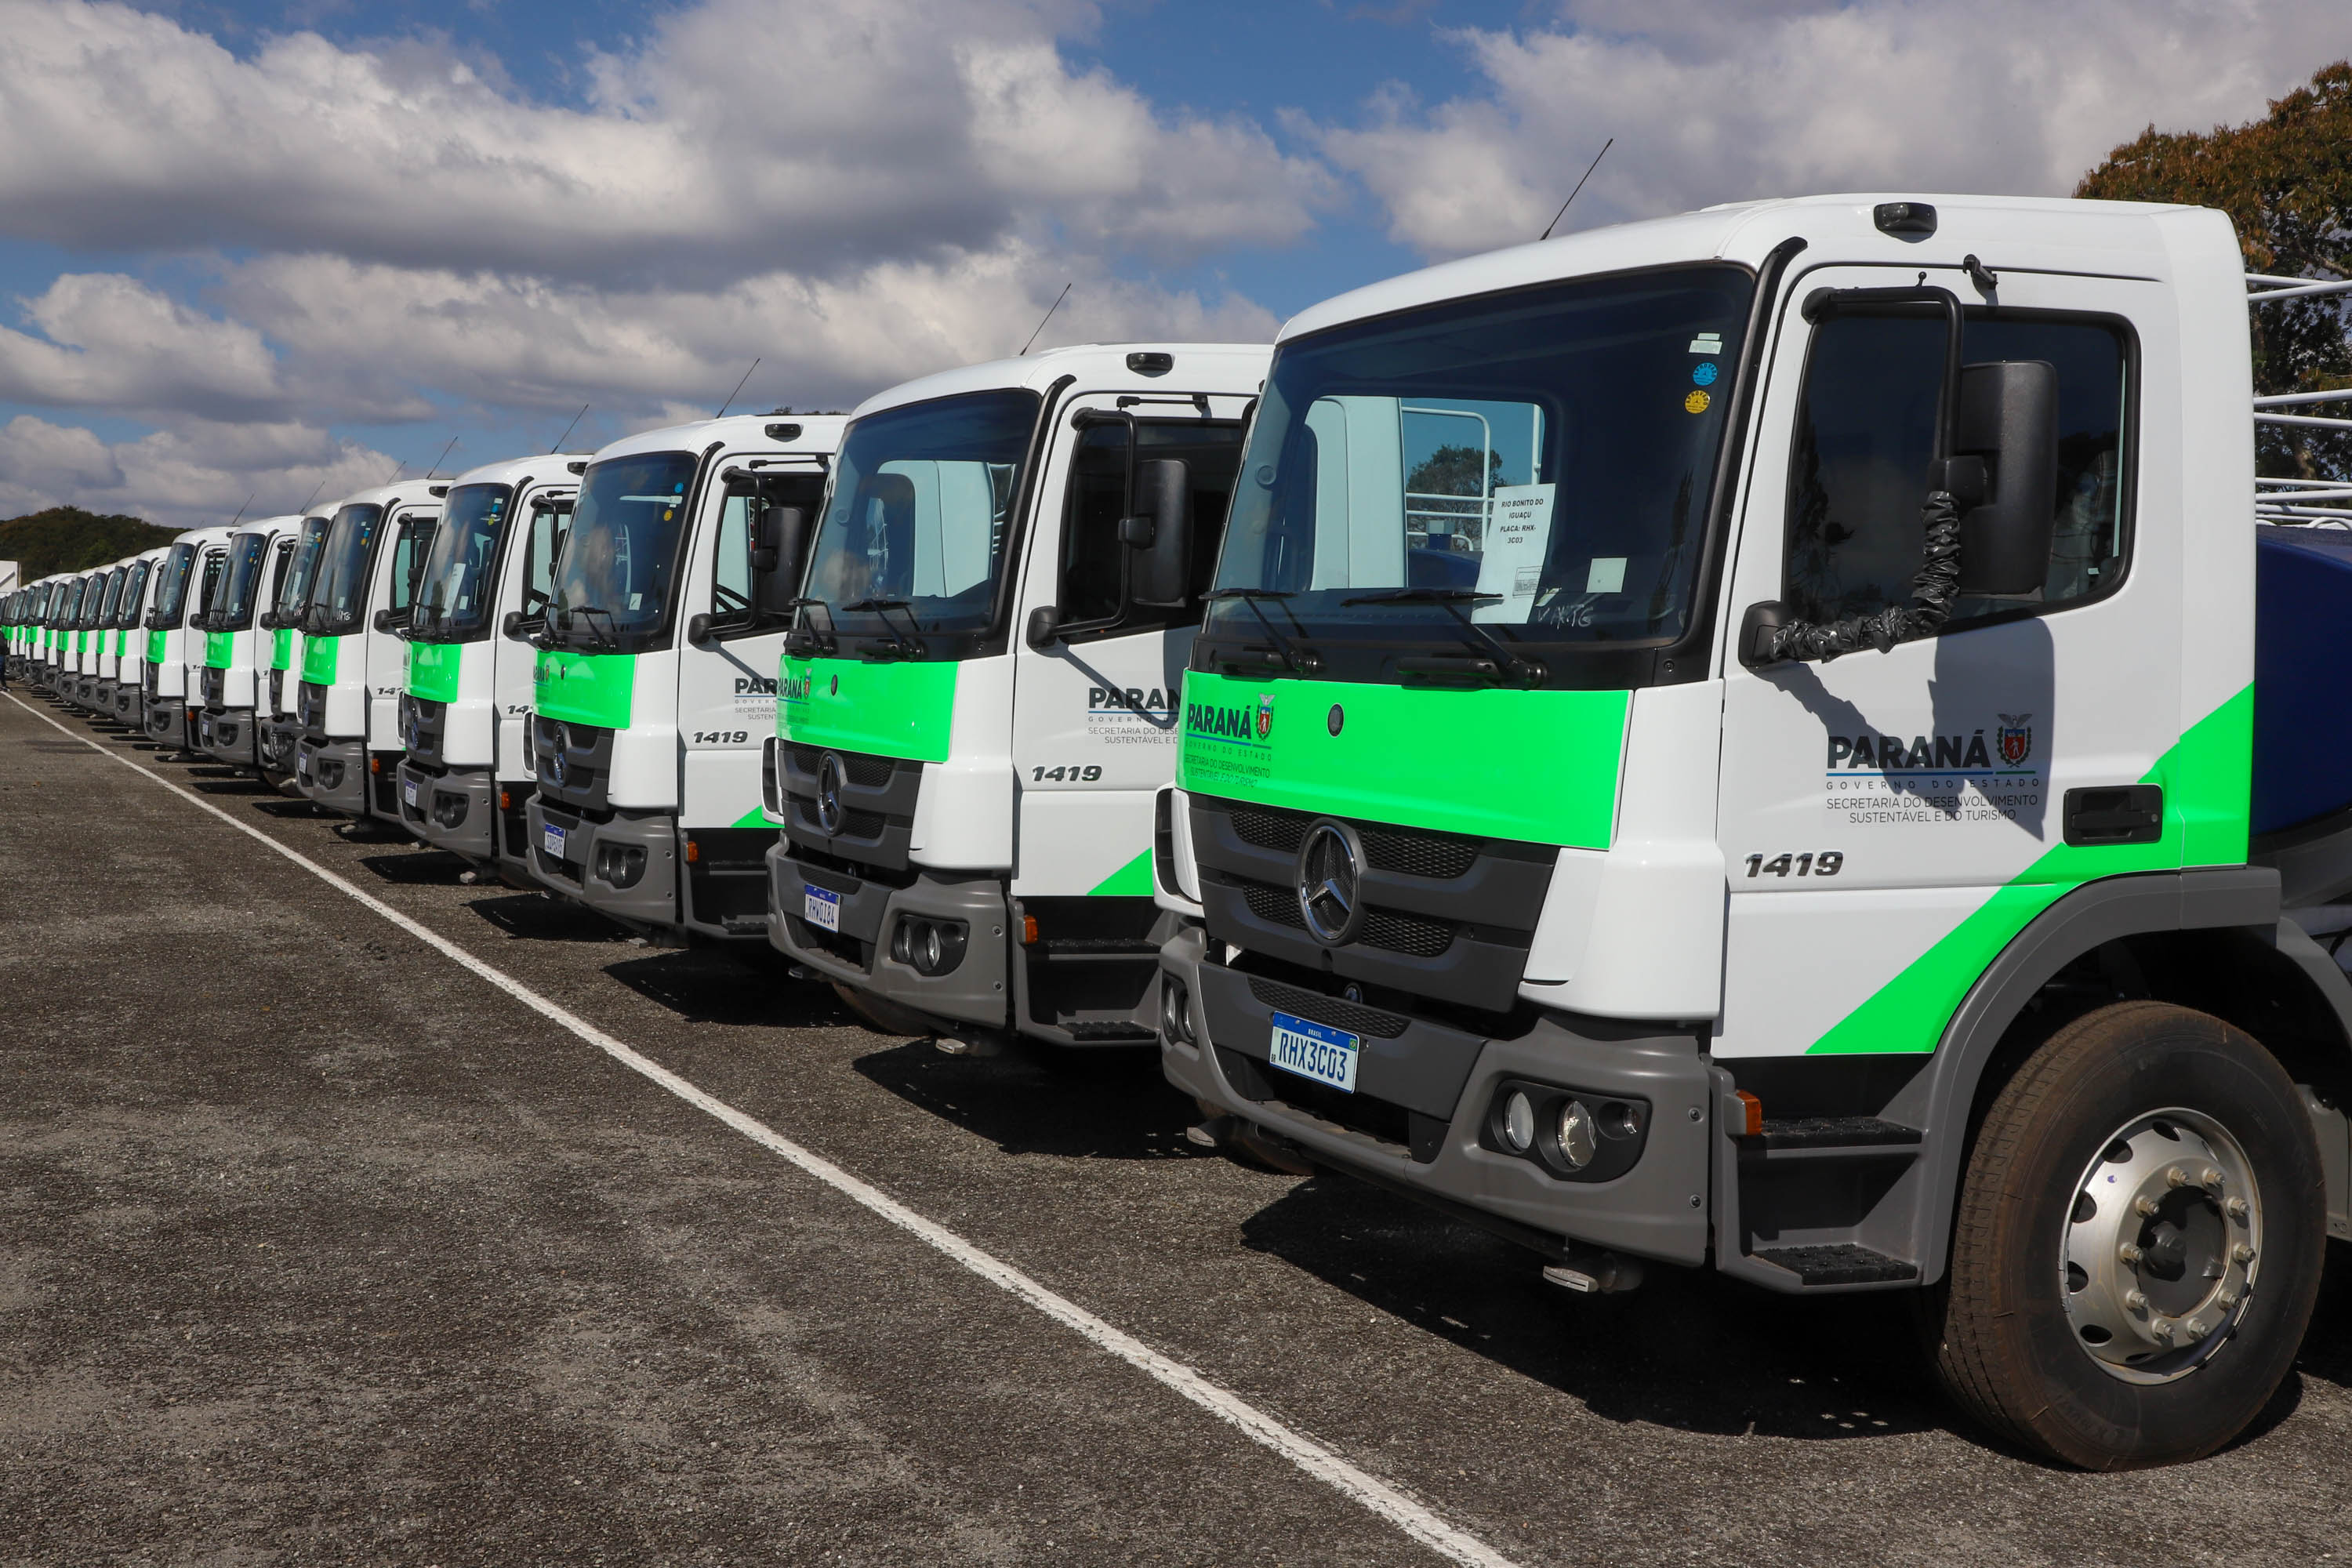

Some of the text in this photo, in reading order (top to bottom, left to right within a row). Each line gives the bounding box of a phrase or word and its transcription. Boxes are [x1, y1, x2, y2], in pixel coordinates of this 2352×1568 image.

[735, 678, 778, 694] PAR
[508, 705, 533, 714] 14
[1187, 702, 1252, 739] PARANÁ
[694, 731, 748, 743] 1419
[1105, 735, 1163, 744] SUSTENTÁVEL
[1223, 746, 1232, 755] DO
[1238, 749, 1272, 761] ESTADO
[1827, 729, 1991, 769] PARANÁ
[1033, 766, 1102, 782] 1419
[1218, 760, 1270, 779] DESENVOLVIMENTO
[1826, 779, 2038, 790] GOVERNO DO ESTADO
[1826, 795, 2038, 809] SECRETARIA DO DESENVOLVIMENTO
[1849, 809, 2016, 823] SUSTENTÁVEL E DO TURISMO
[1744, 851, 1843, 878] 1419
[1279, 1033, 1347, 1082] RHX3C03
